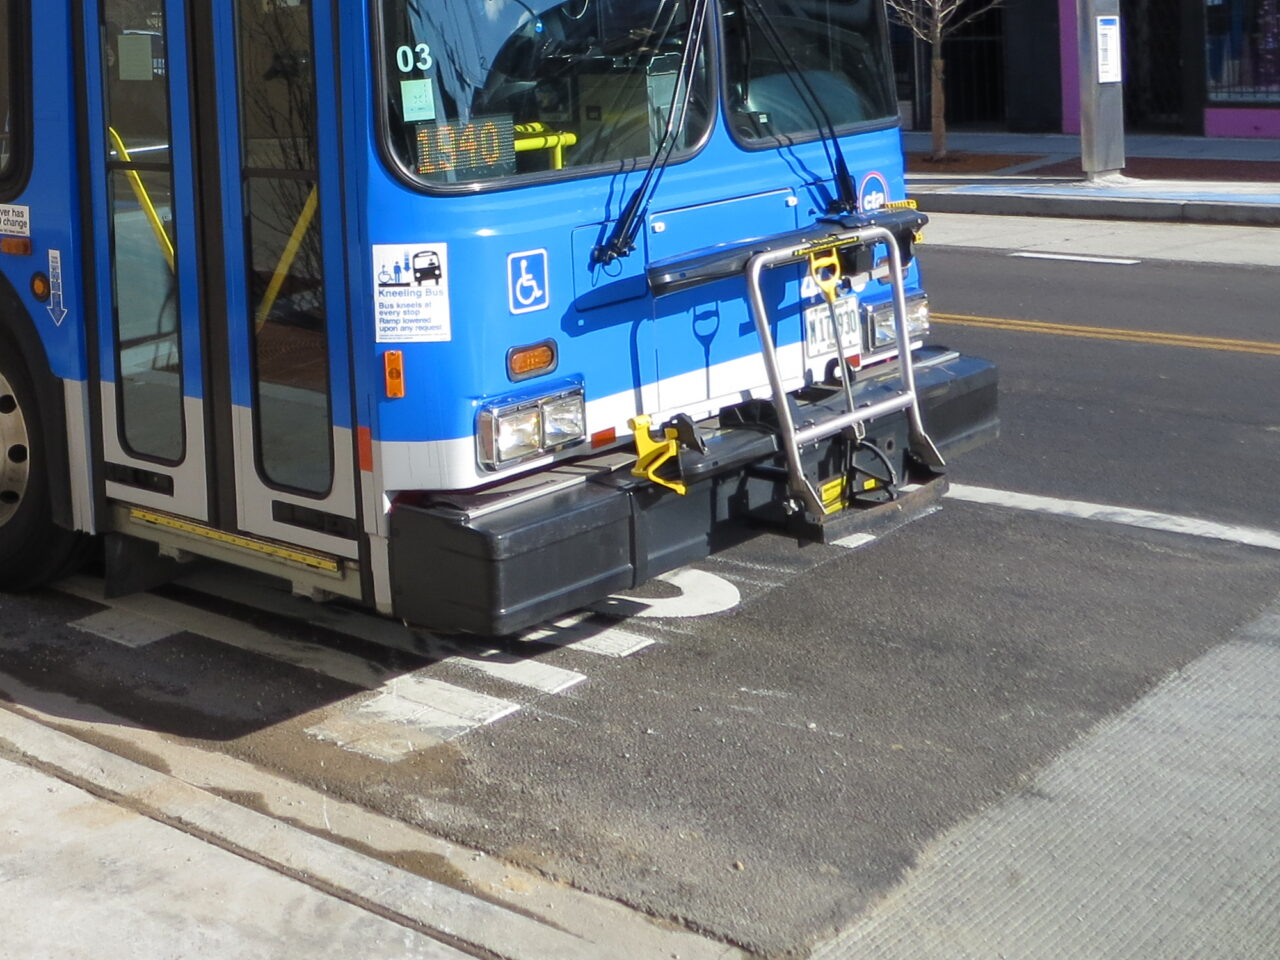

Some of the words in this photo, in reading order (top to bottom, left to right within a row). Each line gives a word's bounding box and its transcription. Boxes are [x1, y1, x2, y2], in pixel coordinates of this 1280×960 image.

[396, 43, 432, 73] 03
[417, 121, 499, 174] 1940
[864, 190, 884, 210] cta
[12, 208, 25, 218] has
[3, 217, 28, 229] change
[378, 288, 422, 299] Kneeling
[425, 288, 444, 297] Bus
[402, 309, 421, 317] stop
[400, 325, 413, 333] any
[415, 324, 442, 332] request
